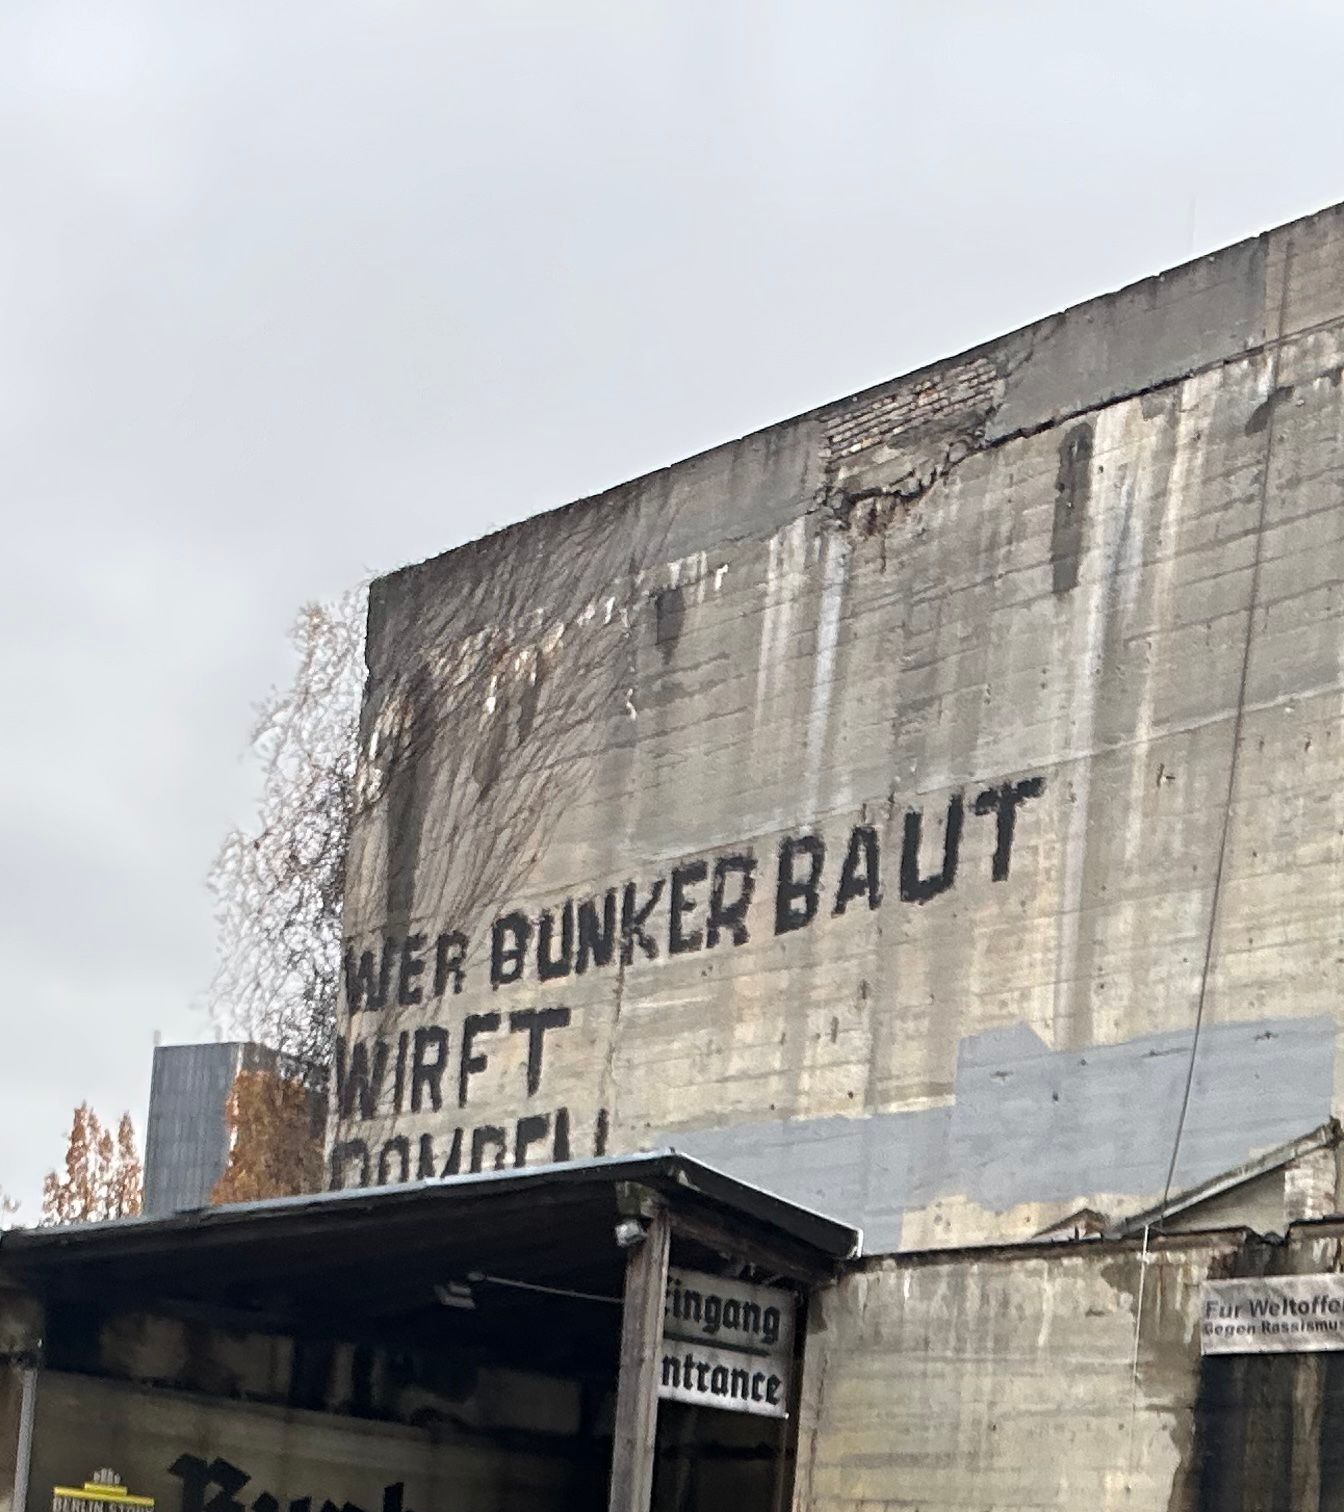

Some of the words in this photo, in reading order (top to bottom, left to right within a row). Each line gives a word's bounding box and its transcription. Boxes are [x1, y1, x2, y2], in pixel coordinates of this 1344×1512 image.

[343, 930, 470, 1013] WER
[490, 856, 758, 989] BUNKER
[774, 775, 1048, 935] BAUT
[337, 1007, 571, 1121] WIRFT
[666, 1275, 781, 1345] ingang
[1204, 1320, 1256, 1338] Gegen
[661, 1353, 782, 1405] ntrance
